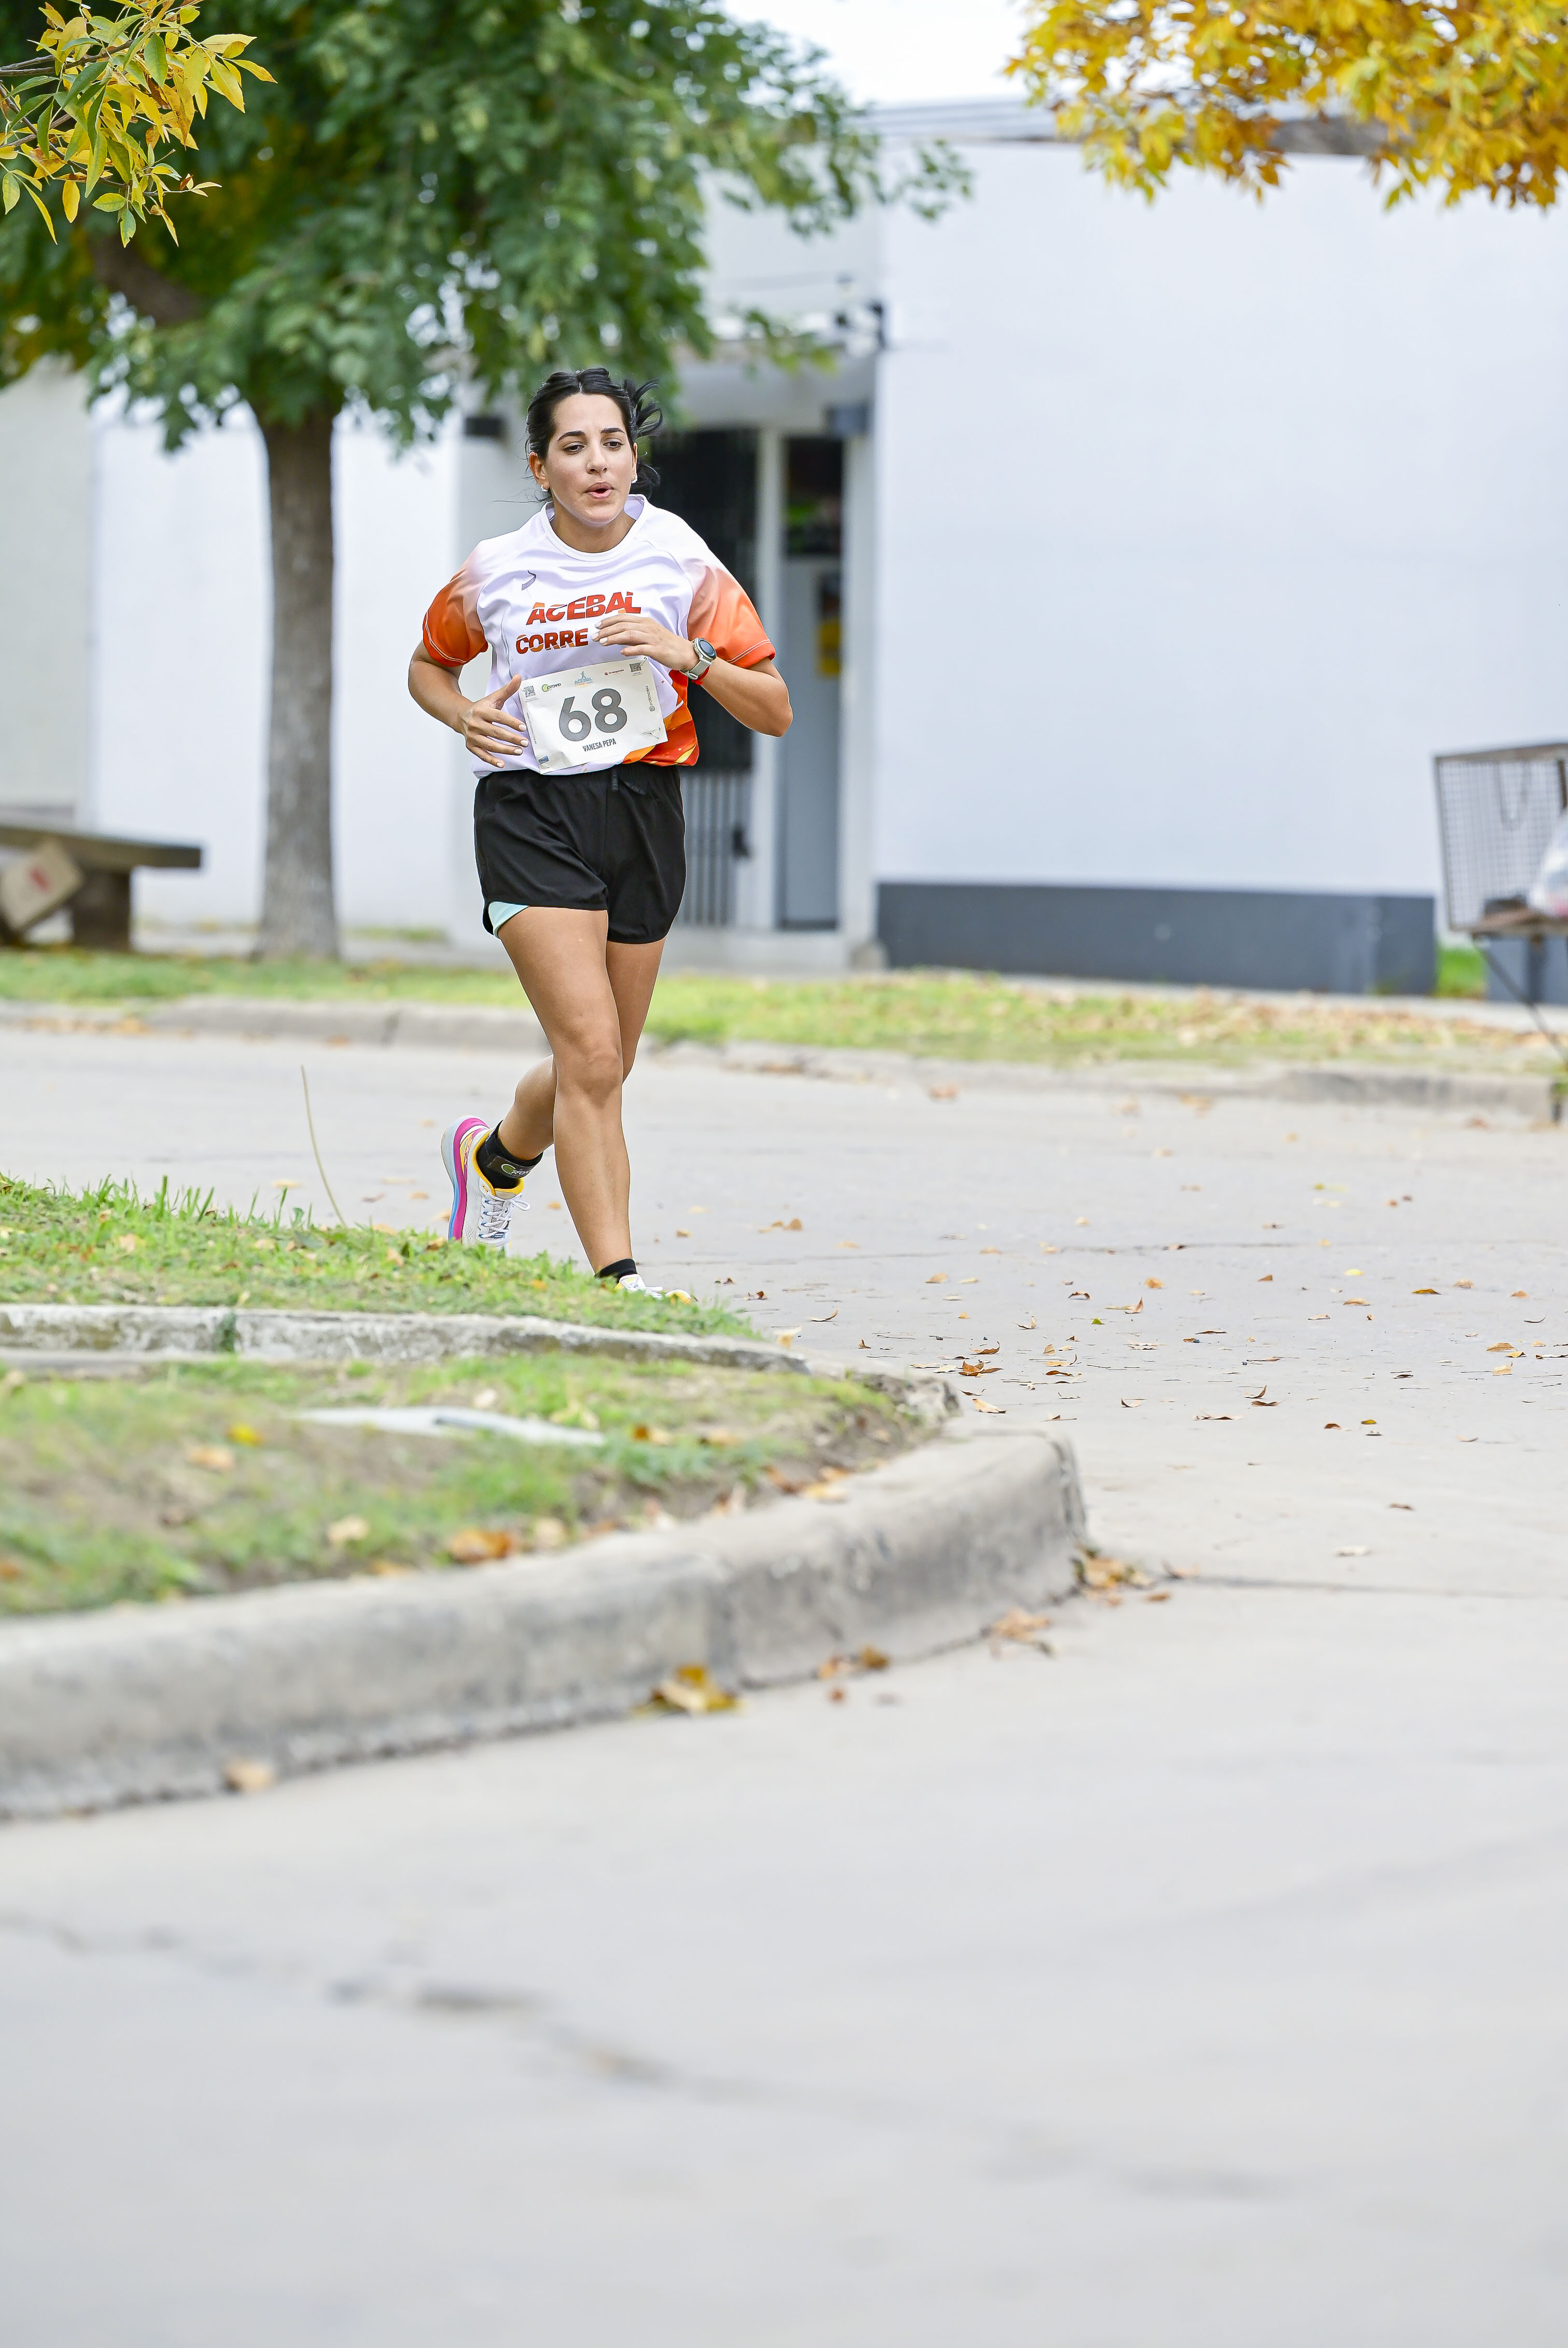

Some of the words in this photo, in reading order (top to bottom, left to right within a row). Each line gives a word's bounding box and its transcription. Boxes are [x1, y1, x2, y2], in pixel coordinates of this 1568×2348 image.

[526, 591, 641, 625] ACEBAL
[516, 627, 589, 654] CORRE
[558, 688, 627, 742] 68
[582, 742, 603, 752] VANESA
[603, 738, 617, 747] PEPA
